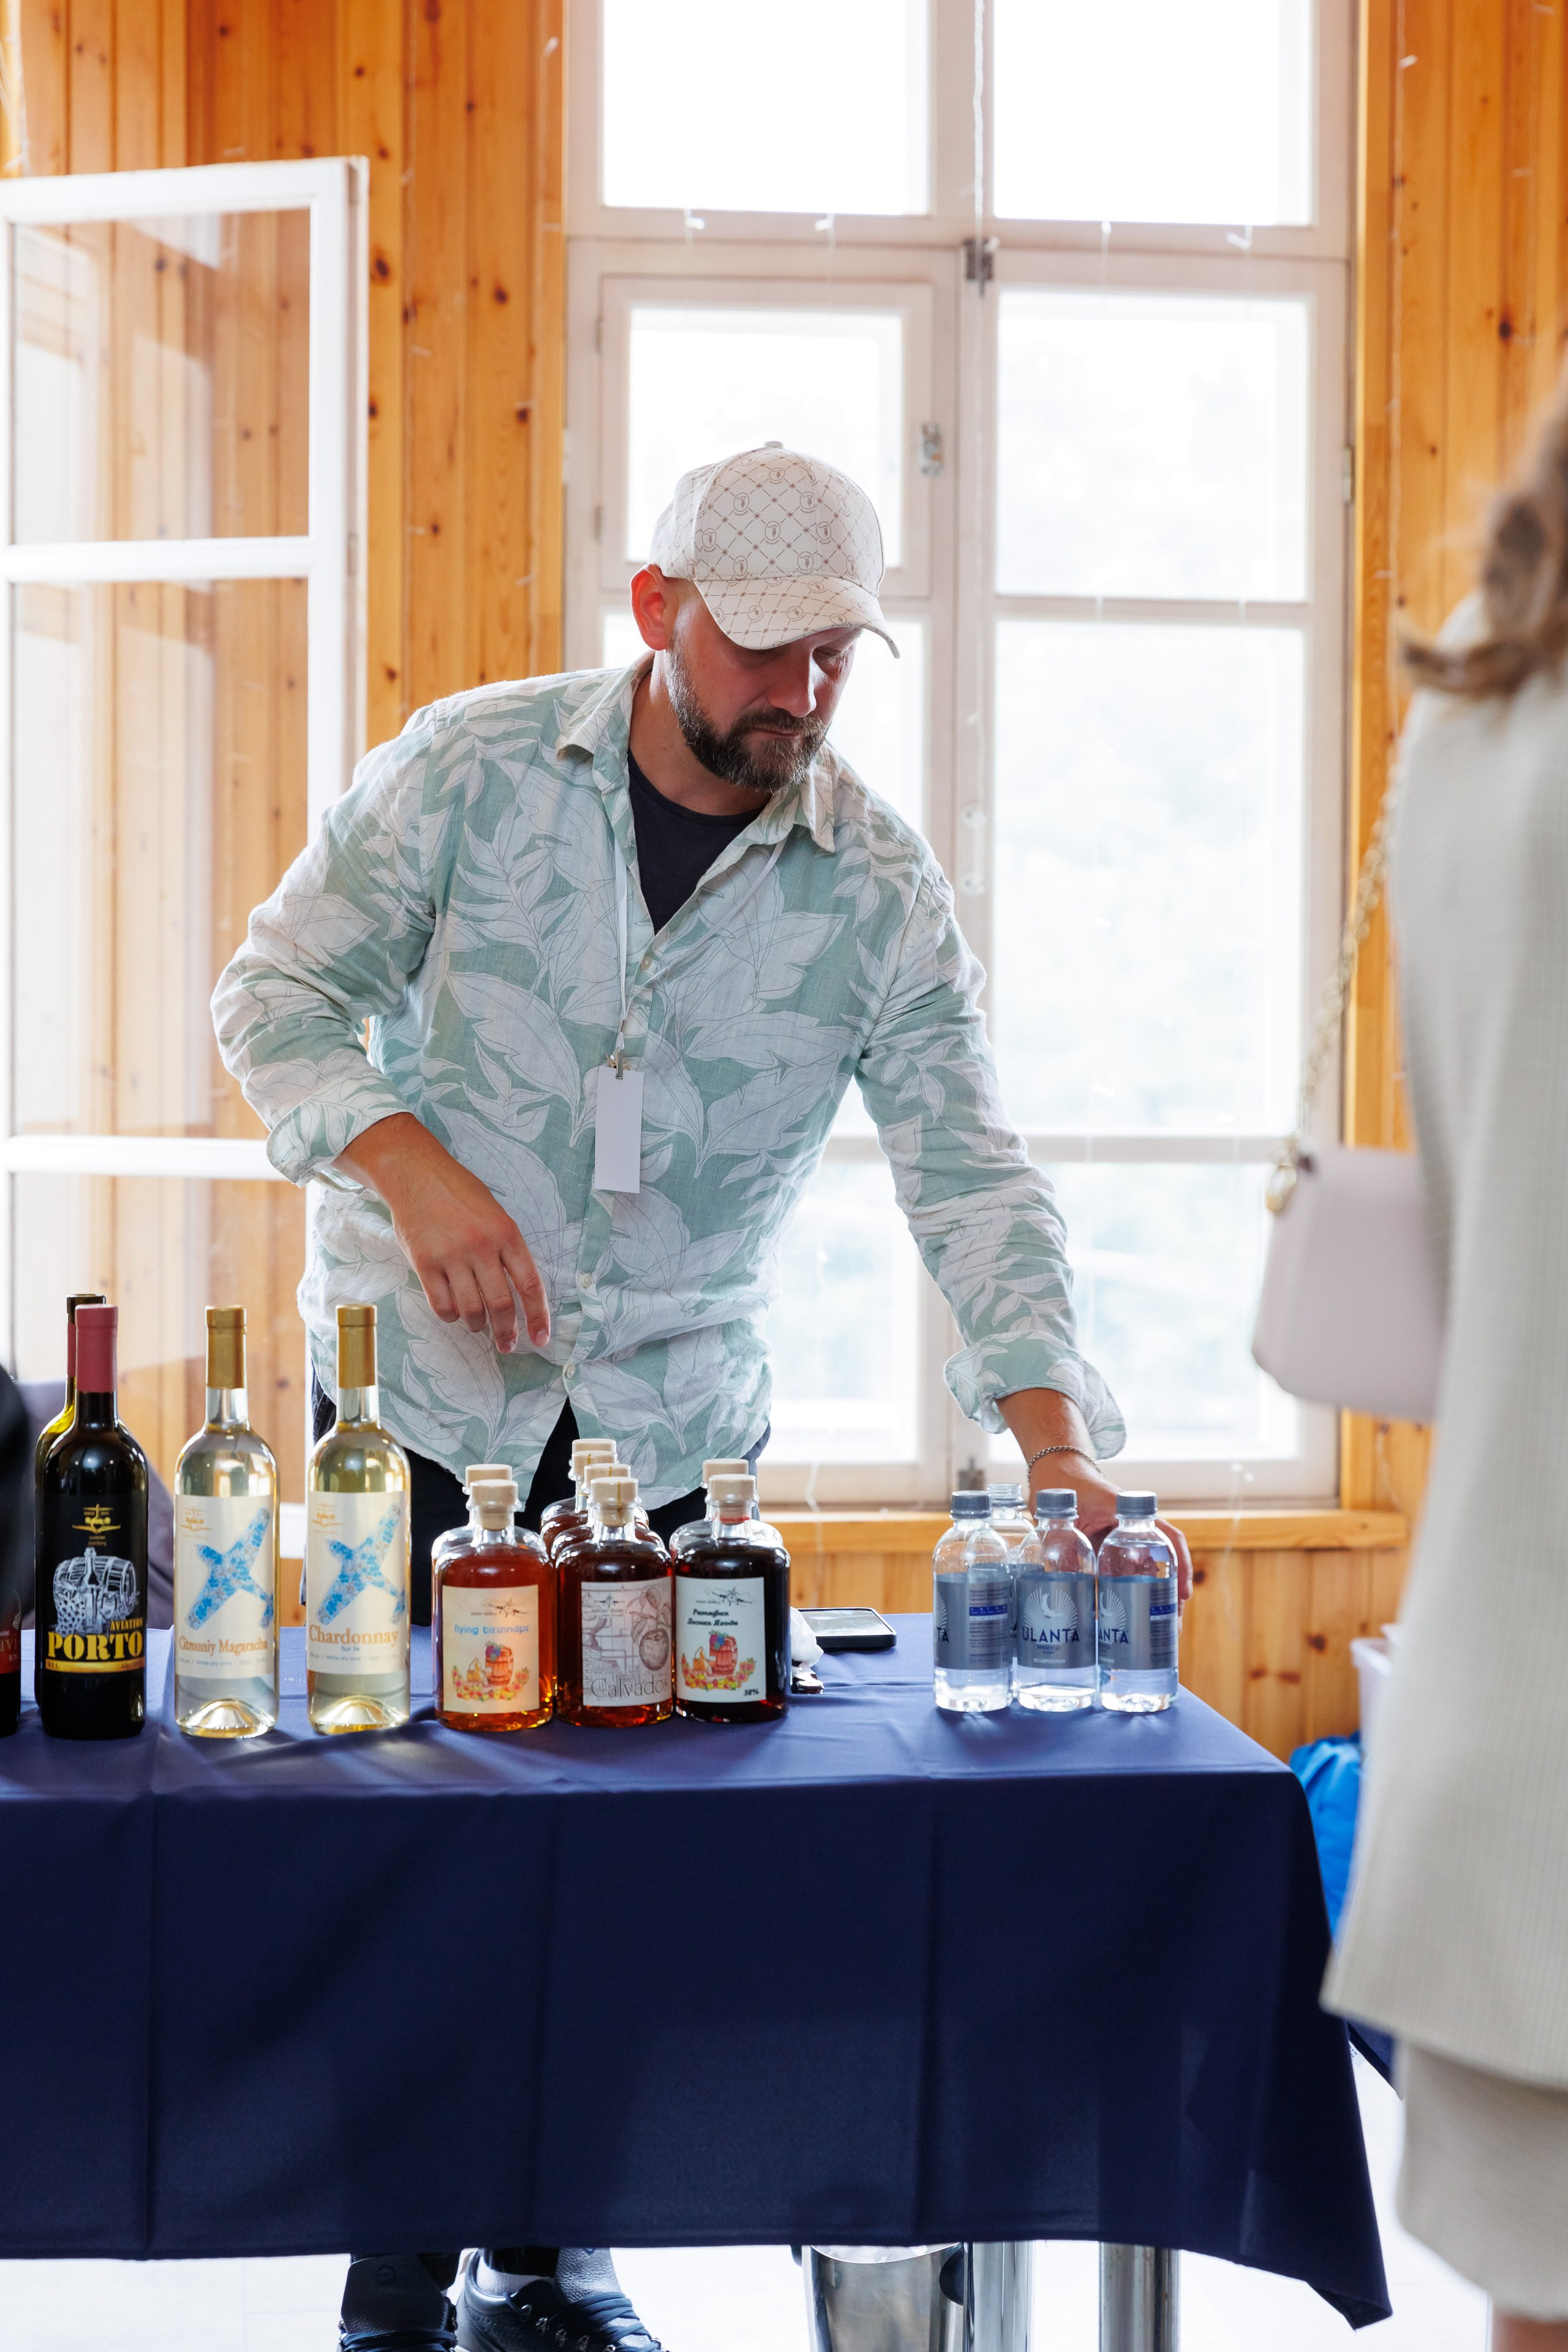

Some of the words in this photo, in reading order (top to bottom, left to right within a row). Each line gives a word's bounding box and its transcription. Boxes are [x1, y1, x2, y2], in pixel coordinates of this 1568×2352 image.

[309, 1624, 399, 1648] Chardonnay
[454, 1624, 479, 1635] flying
[1022, 1627, 1080, 1643] ULANTA
[48, 1630, 143, 1660] PORTO
[591, 1675, 668, 1698] Calvados
